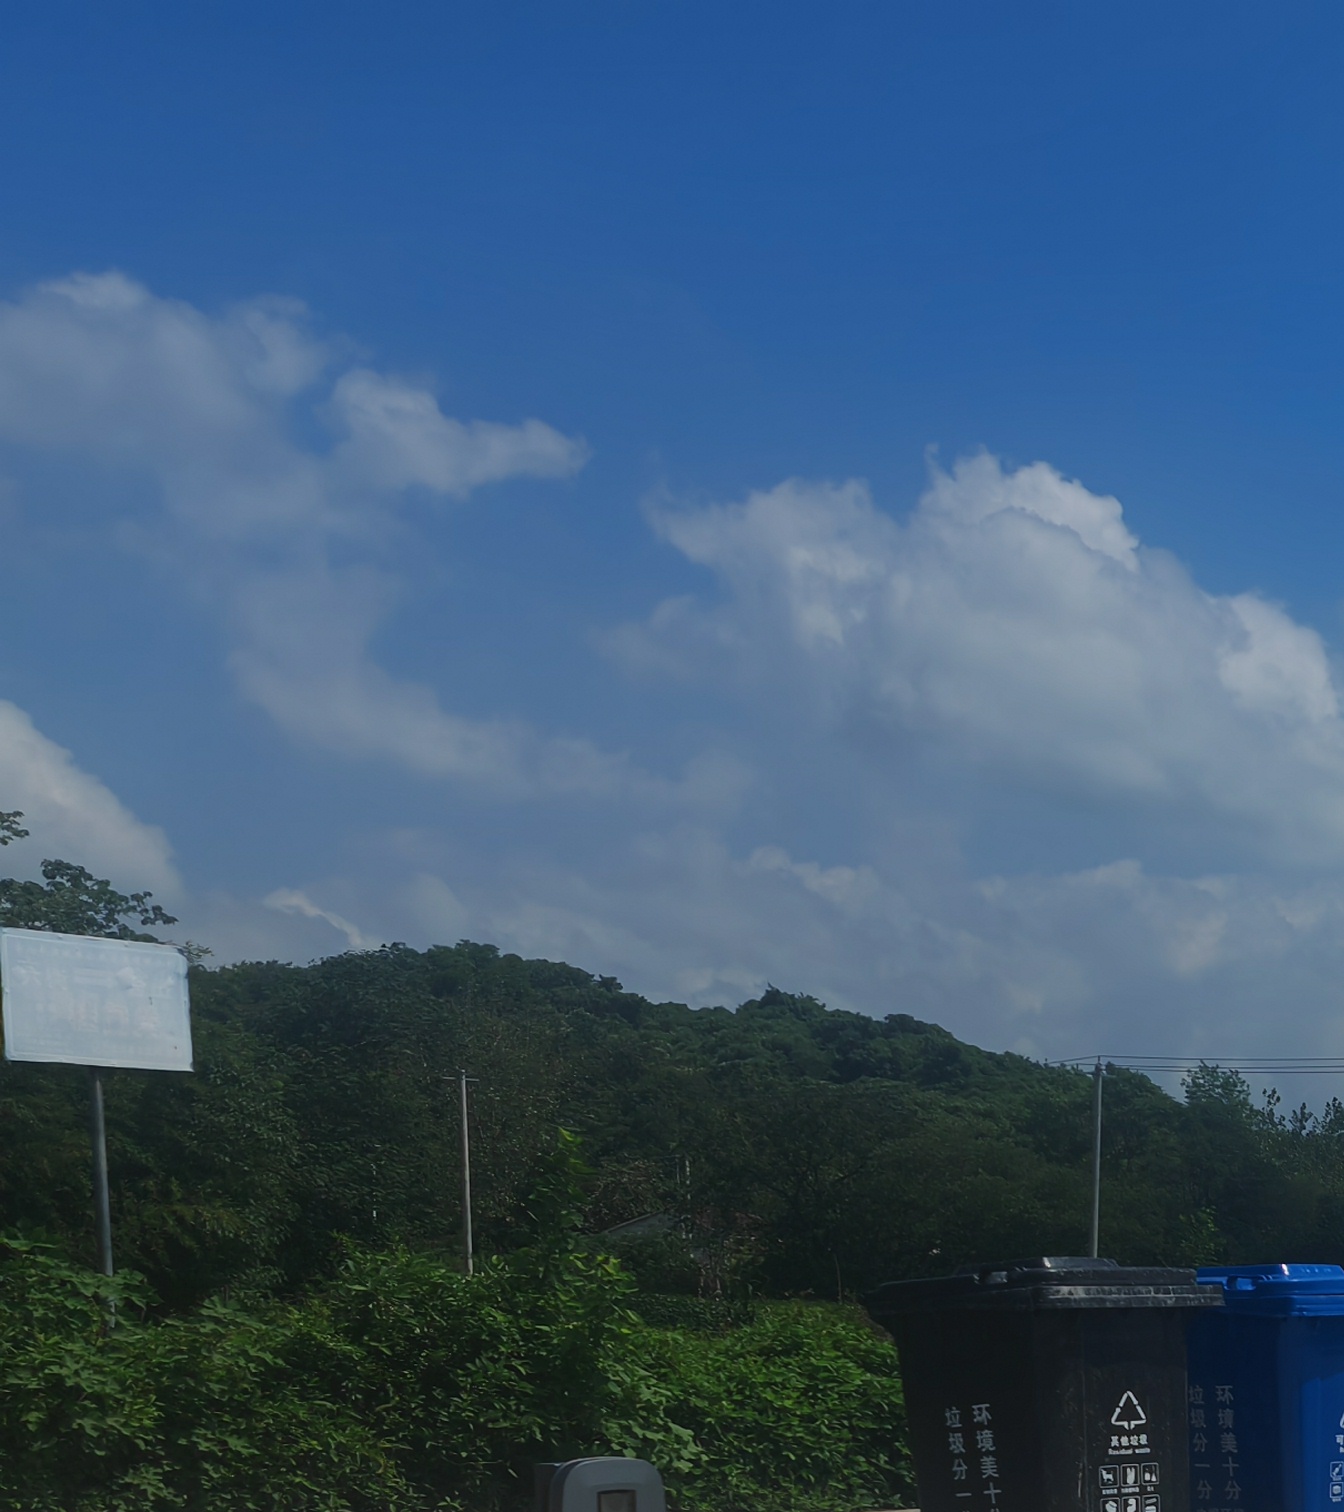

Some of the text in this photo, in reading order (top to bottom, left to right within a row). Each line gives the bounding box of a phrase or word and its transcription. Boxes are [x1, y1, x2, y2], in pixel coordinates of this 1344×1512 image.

[1110, 1433, 1148, 1447] 其他垃圾
[1214, 1384, 1242, 1501] 环境美十分
